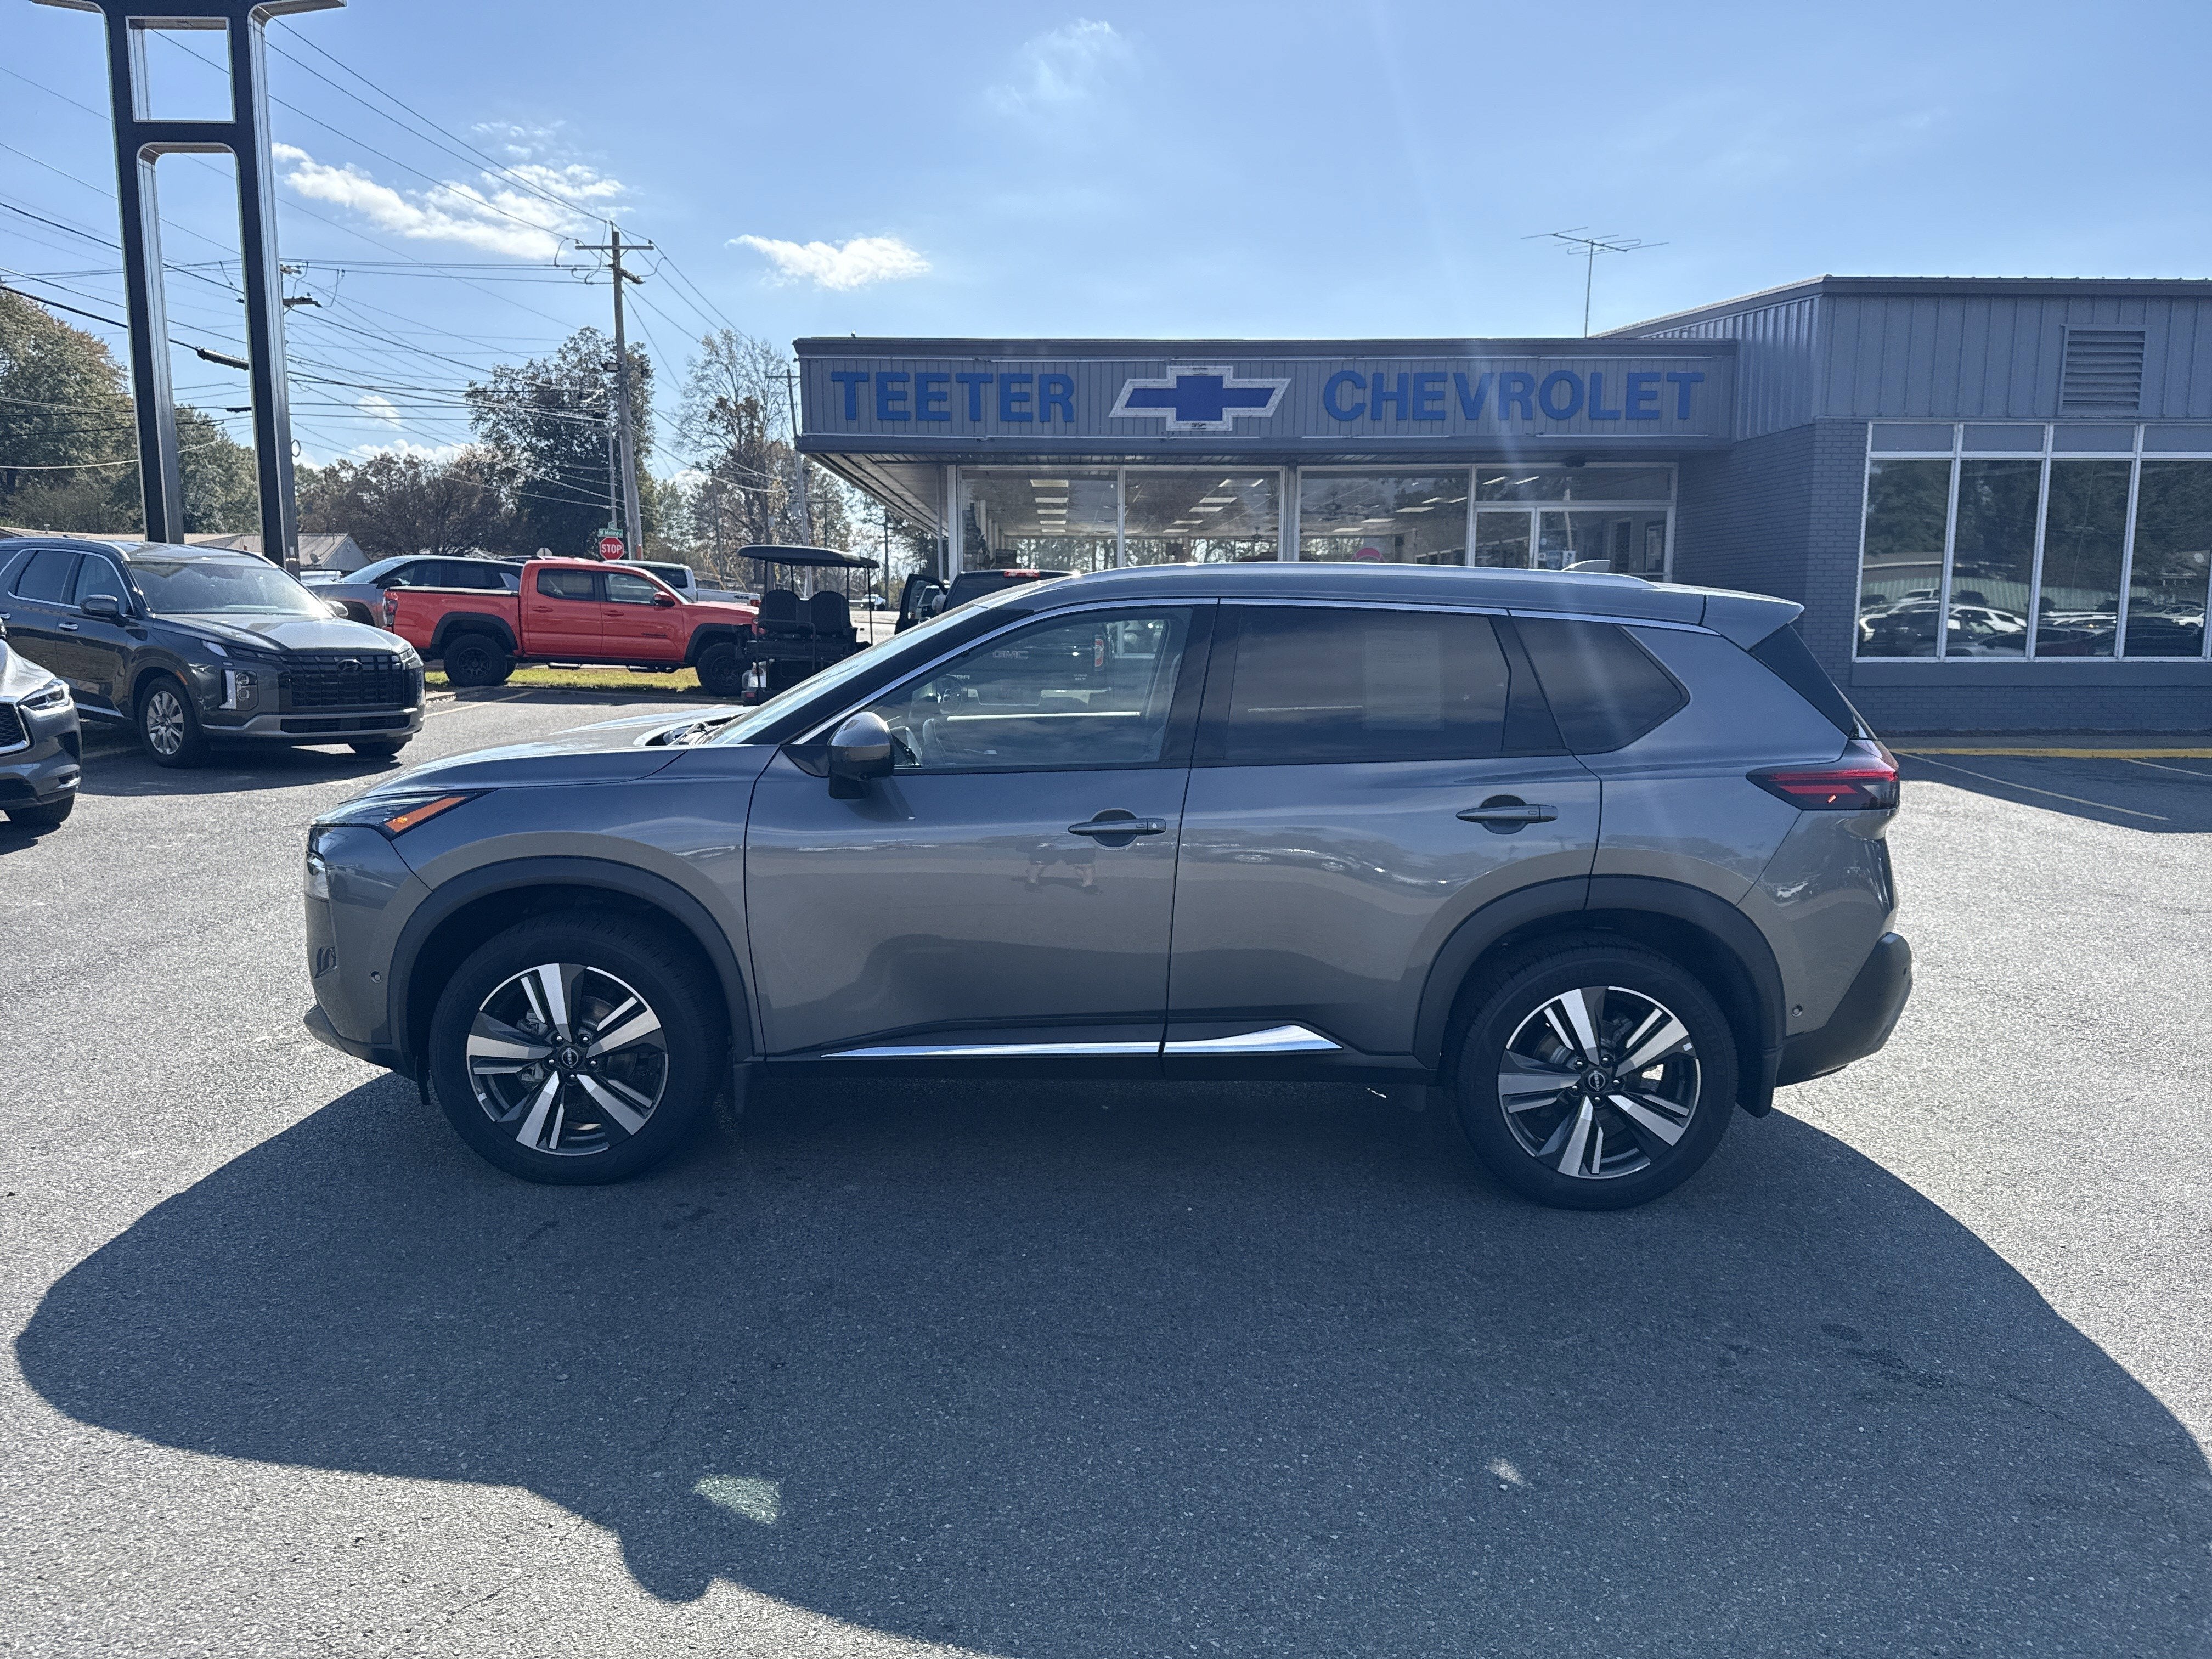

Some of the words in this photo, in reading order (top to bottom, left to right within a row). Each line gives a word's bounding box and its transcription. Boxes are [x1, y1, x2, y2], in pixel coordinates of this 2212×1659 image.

[831, 371, 1075, 422] TEETER
[1323, 369, 1705, 421] CHEVROLET
[601, 544, 622, 554] STOP
[992, 650, 1029, 659] GMC
